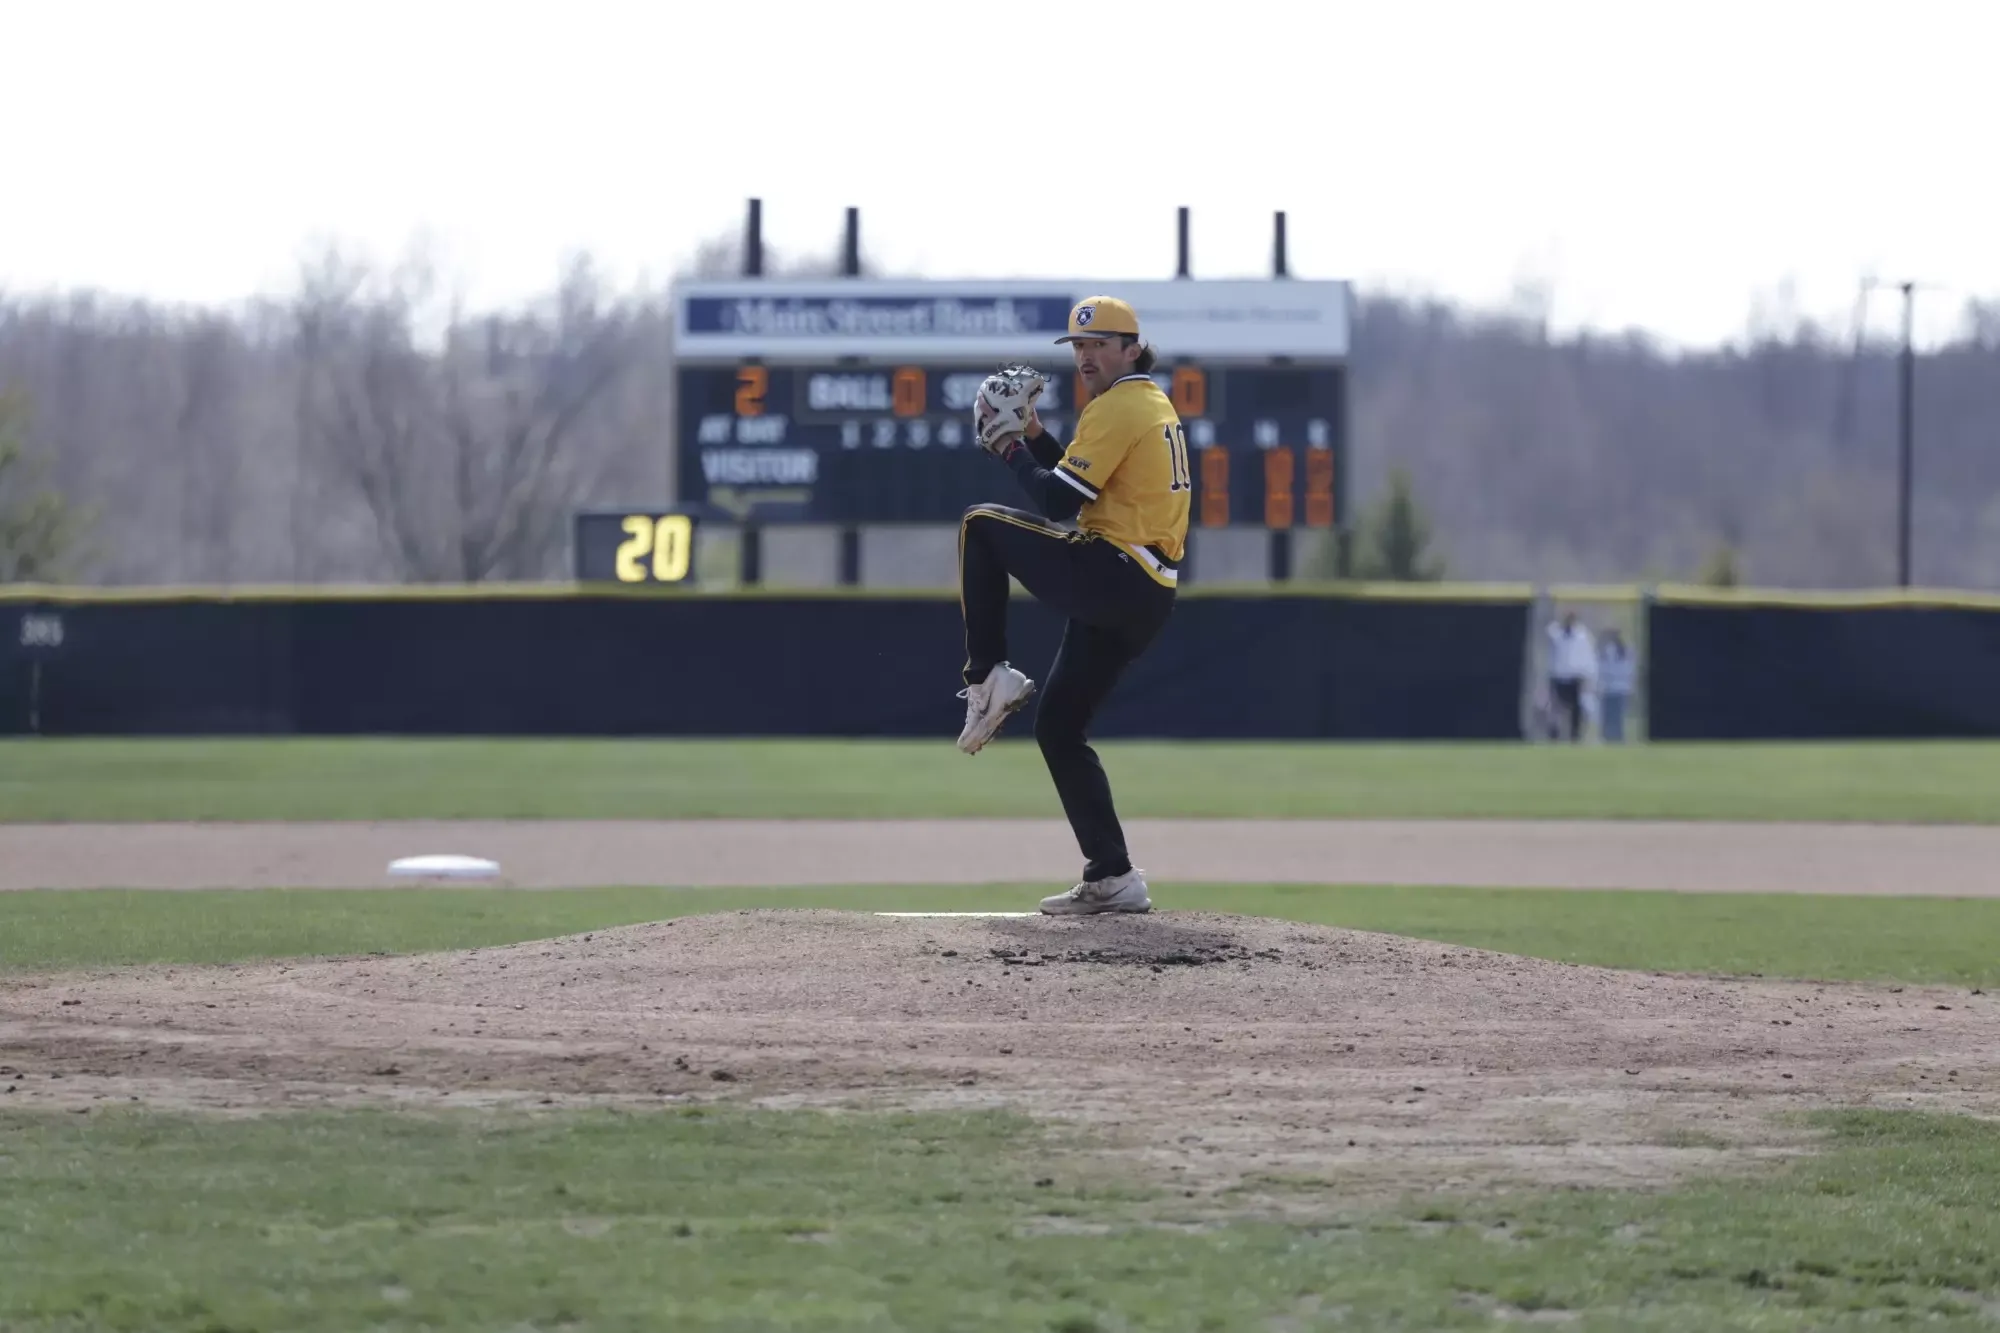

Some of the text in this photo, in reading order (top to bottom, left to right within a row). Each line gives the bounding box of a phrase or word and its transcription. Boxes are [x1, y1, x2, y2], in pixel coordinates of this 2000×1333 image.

[736, 299, 1022, 334] Main Street Bank
[735, 366, 768, 417] 2
[808, 374, 889, 410] BALL
[892, 367, 926, 417] 0
[943, 374, 1060, 410] STE
[1172, 366, 1206, 417] 0
[701, 450, 818, 484] VISITOR
[1164, 423, 1191, 493] 10
[615, 513, 692, 582] 20
